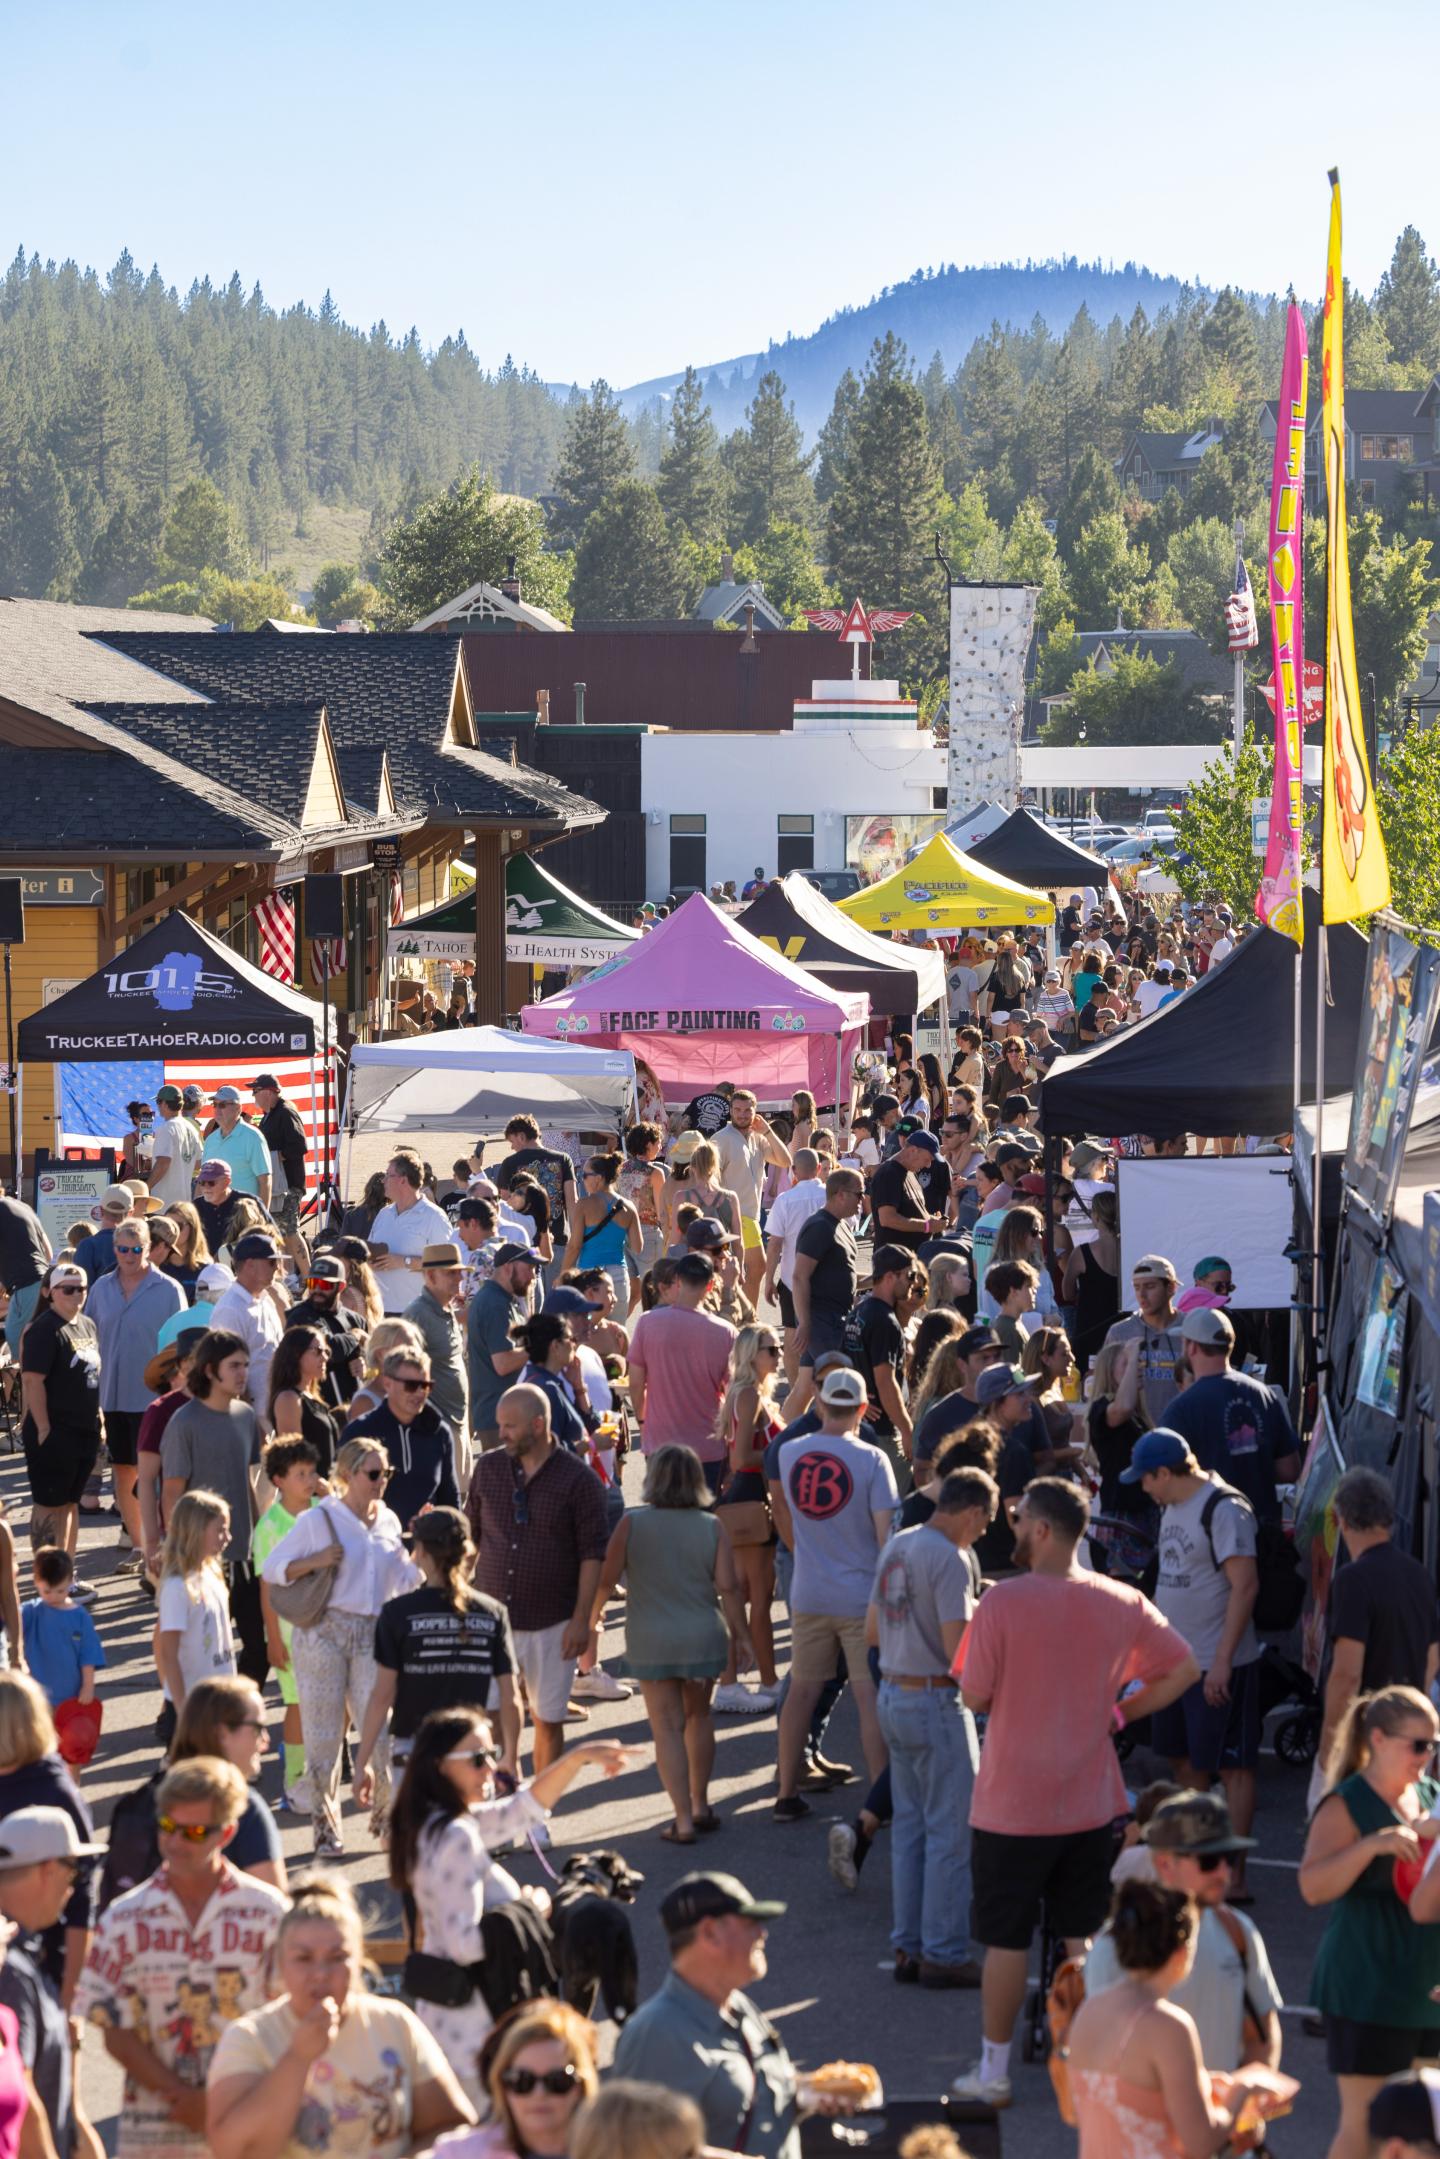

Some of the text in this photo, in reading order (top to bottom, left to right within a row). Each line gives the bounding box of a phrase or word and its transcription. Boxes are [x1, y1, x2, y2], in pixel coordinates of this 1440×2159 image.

[423, 940, 467, 954] TAHOE
[525, 943, 575, 958] HEALTH
[104, 967, 235, 994] 101.5
[609, 1010, 761, 1032] FACE PAINTING
